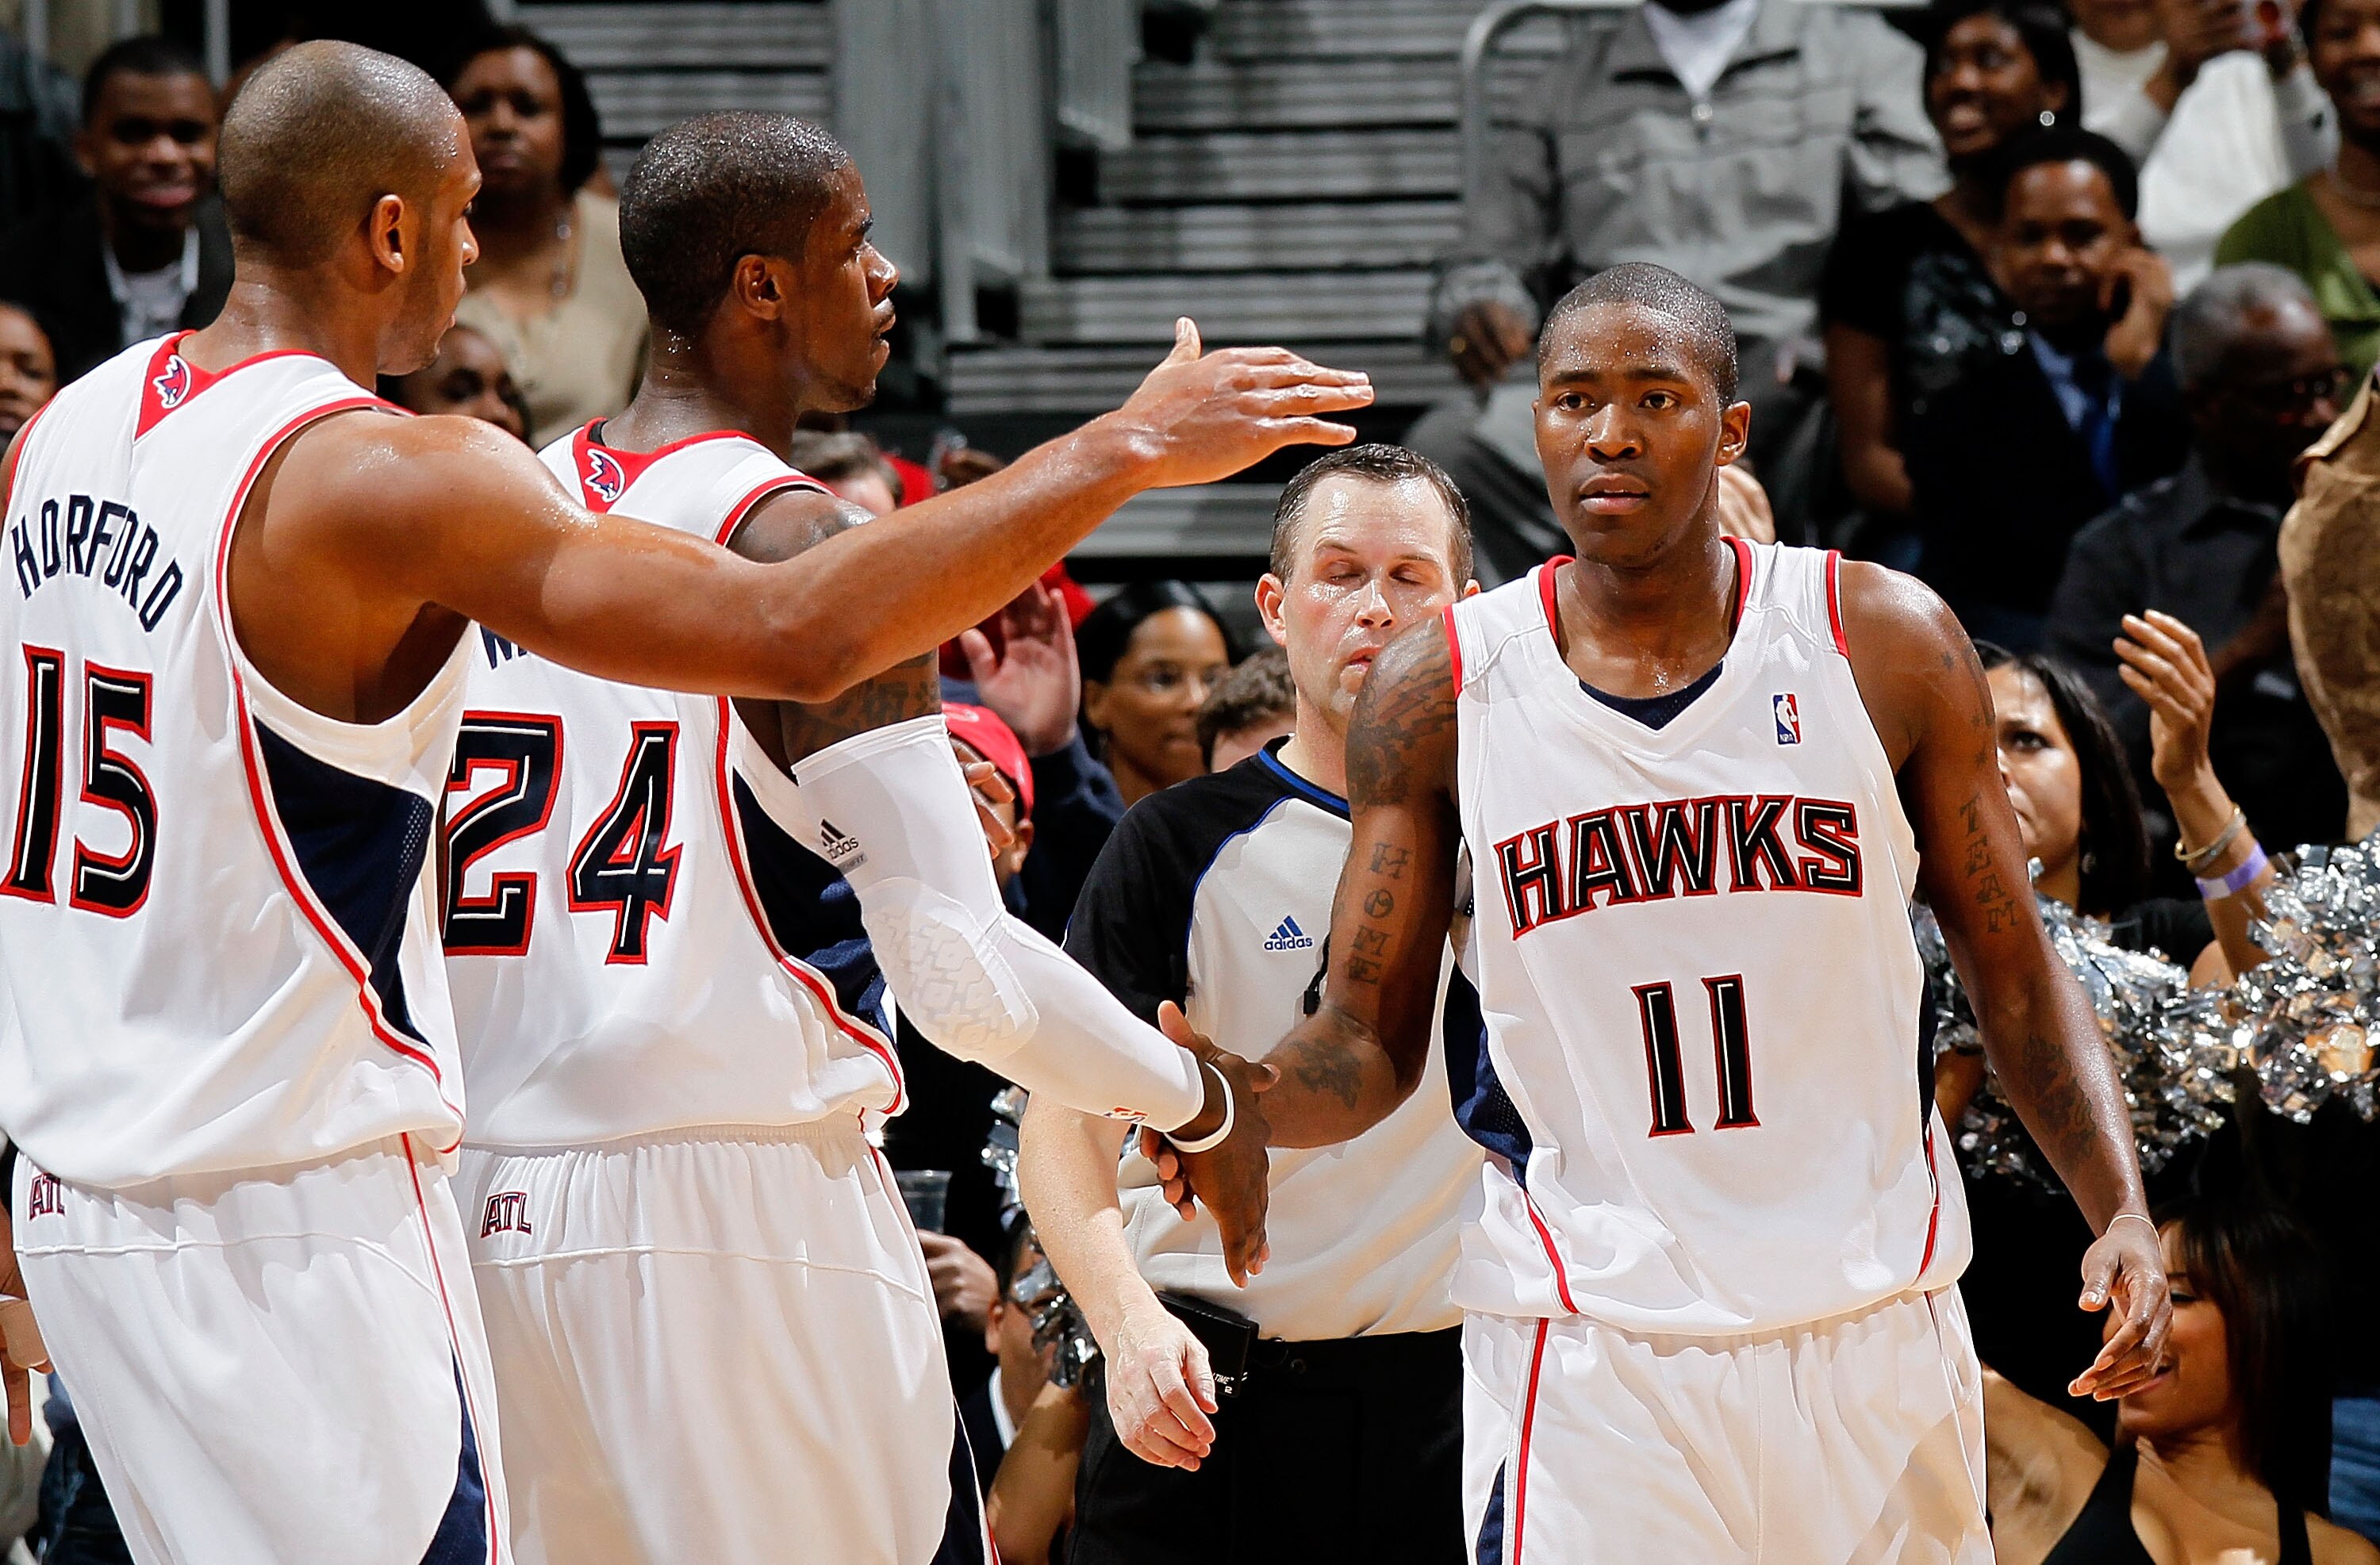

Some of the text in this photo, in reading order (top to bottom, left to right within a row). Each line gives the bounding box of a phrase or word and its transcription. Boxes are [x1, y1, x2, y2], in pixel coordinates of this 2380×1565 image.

[11, 494, 183, 633] HORFORD
[0, 642, 158, 919] 15
[443, 710, 685, 965] 24
[1345, 841, 1411, 985] HOME
[1494, 794, 1864, 941] HAWKS
[1960, 791, 2019, 934] TEAM
[1264, 936, 1313, 950] adidas
[1630, 973, 1762, 1137] 11
[29, 1172, 66, 1221] ATL
[480, 1191, 532, 1238] ATL
